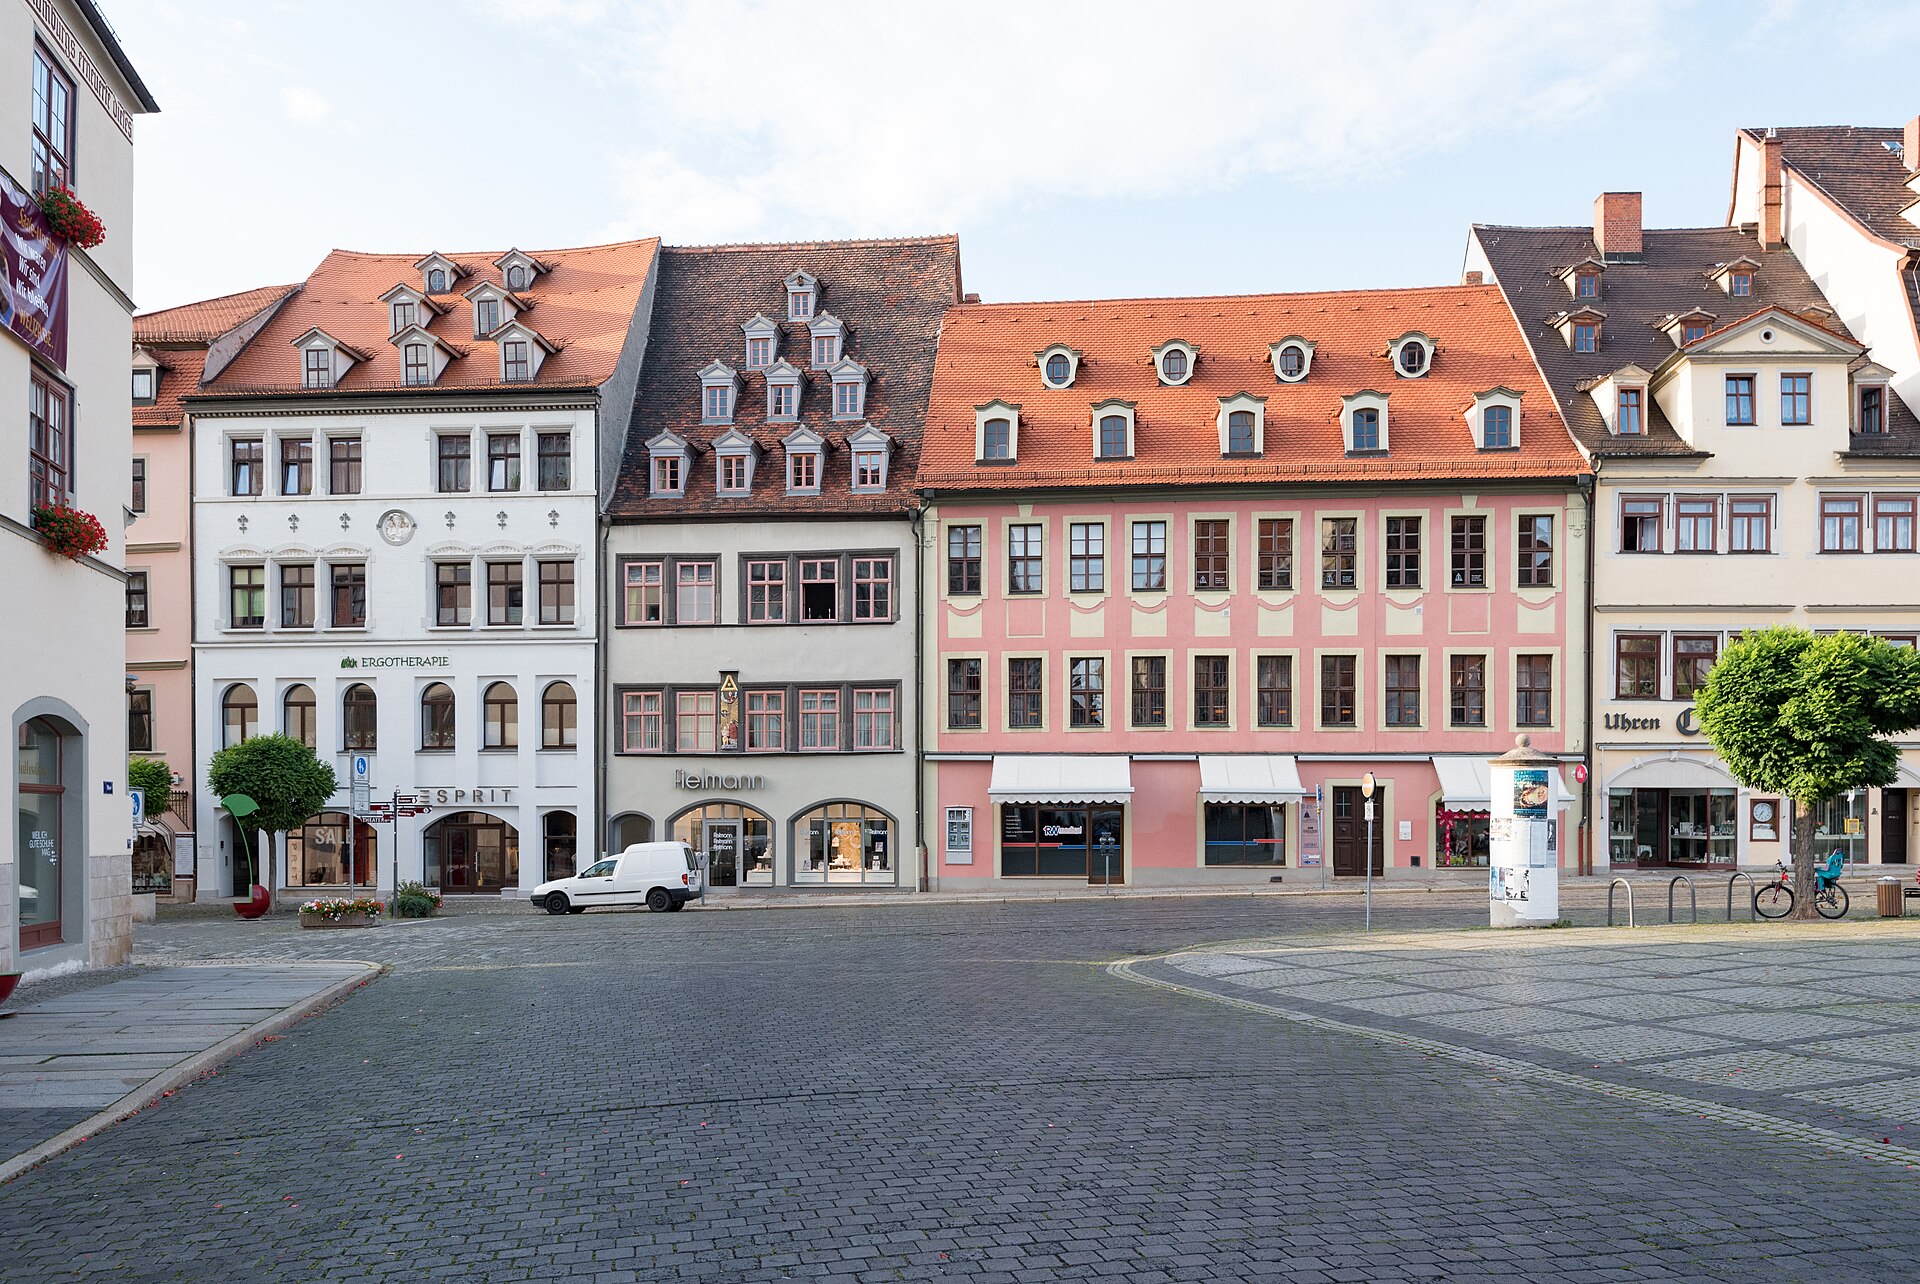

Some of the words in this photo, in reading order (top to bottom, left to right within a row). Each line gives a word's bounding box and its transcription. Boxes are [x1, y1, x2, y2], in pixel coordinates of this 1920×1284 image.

[33, 0, 75, 59] umburgs
[15, 233, 27, 255] Wir
[18, 256, 29, 274] Wir
[29, 271, 41, 289] sind
[16, 278, 27, 297] Wir
[27, 289, 49, 318] bleiben
[361, 656, 450, 667] ERGOTHERAPIE
[1604, 712, 1661, 732] Uhren
[420, 789, 512, 804] ESPRIT
[315, 828, 351, 844] SALE
